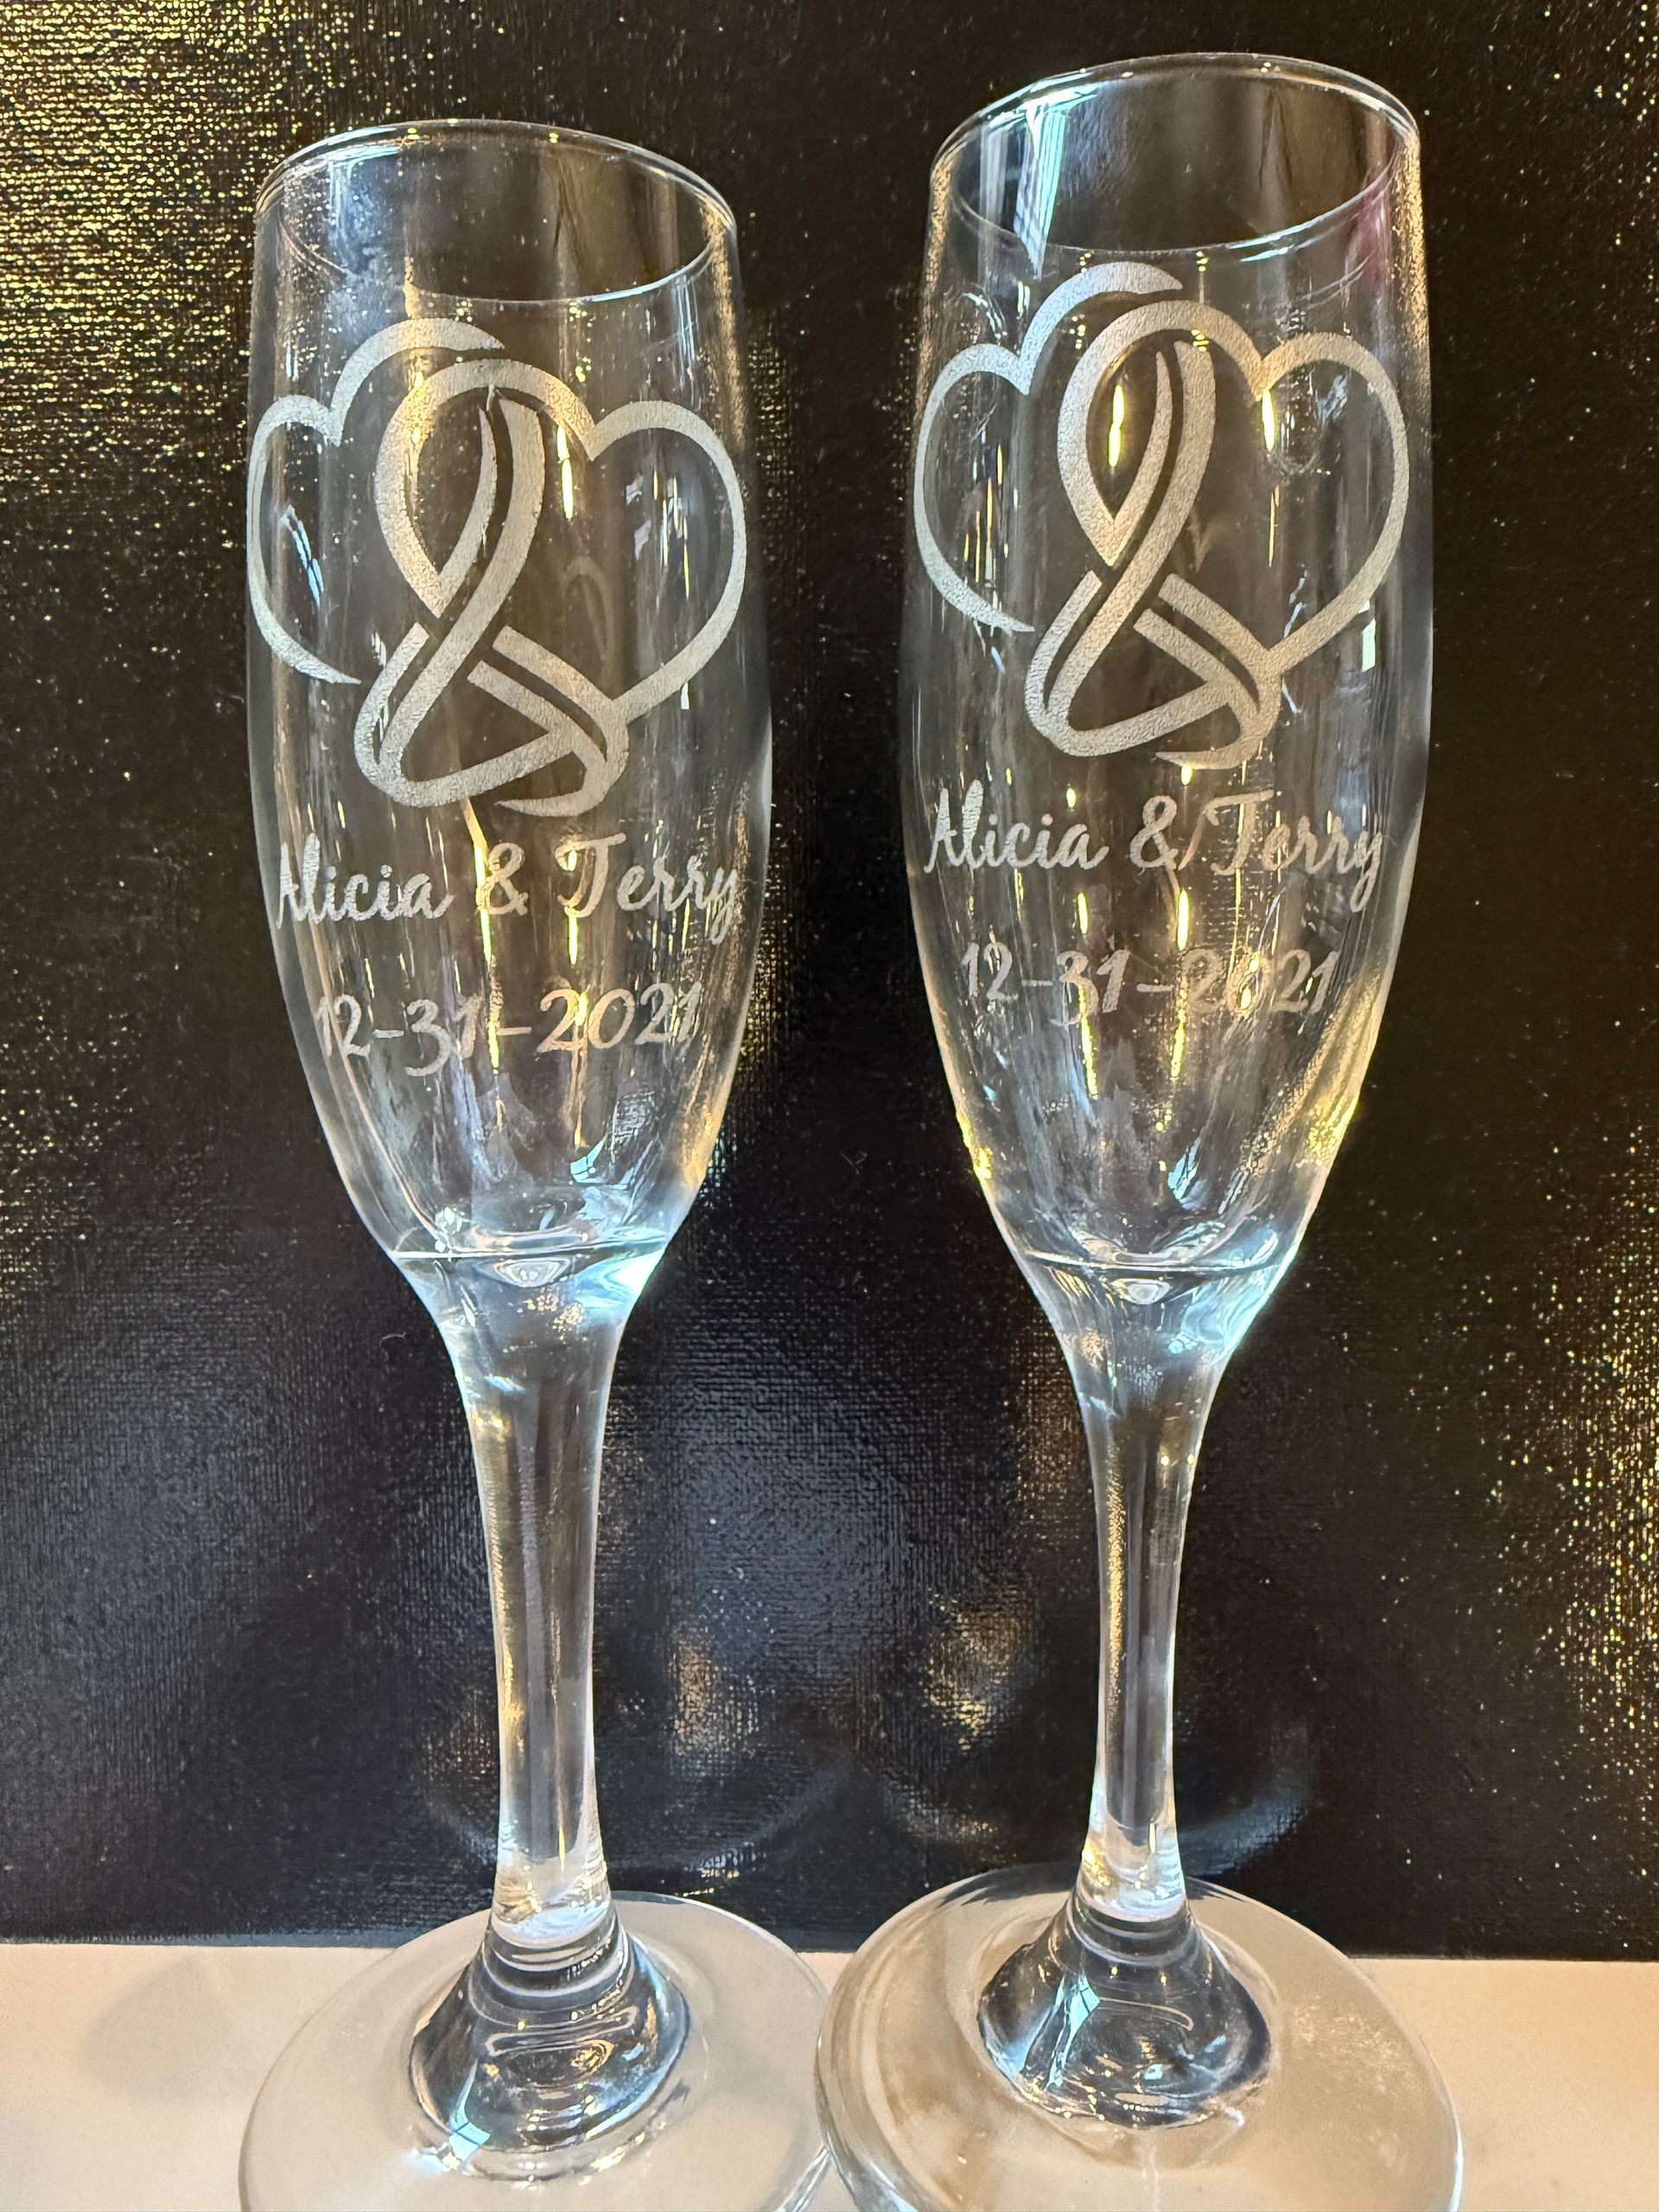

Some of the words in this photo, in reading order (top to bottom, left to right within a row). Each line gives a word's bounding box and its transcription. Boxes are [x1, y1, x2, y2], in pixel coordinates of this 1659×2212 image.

[276, 832, 455, 930] Alicia
[476, 842, 531, 917] &
[555, 831, 739, 945] Terry
[924, 779, 1110, 874] Alicia
[1129, 795, 1181, 874] &
[1203, 789, 1383, 913] Terry
[315, 981, 703, 1077] 12-31-2021
